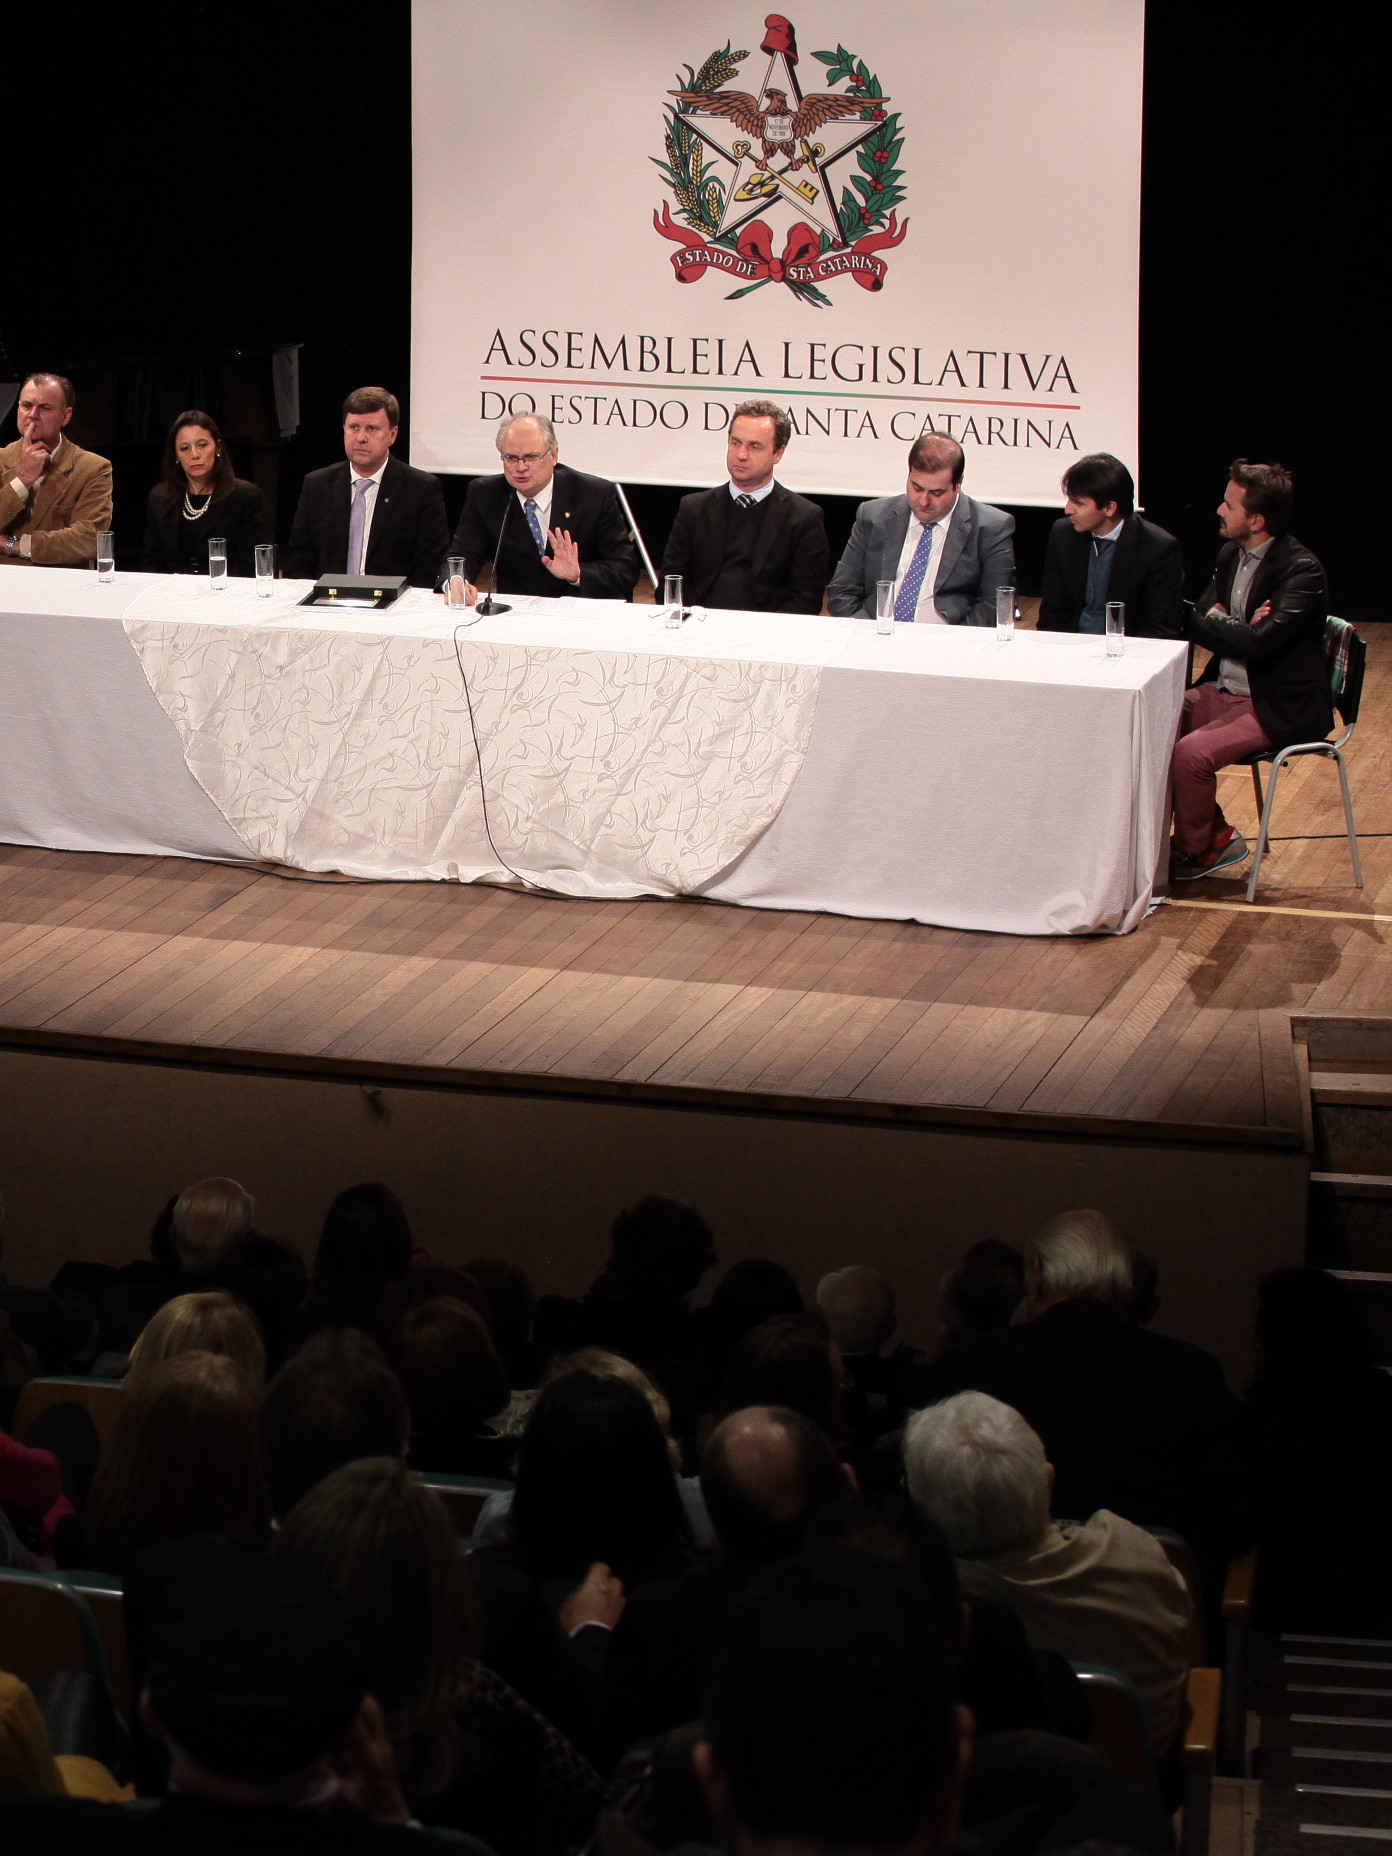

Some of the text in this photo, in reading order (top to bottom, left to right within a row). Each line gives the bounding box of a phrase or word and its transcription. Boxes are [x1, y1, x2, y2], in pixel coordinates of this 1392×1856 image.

[676, 250, 734, 268] ESTADO
[735, 260, 757, 277] DE
[818, 254, 883, 276] CATARINA
[481, 328, 1081, 394] ASSEMBLEIA LEGISLATIVA
[479, 390, 1081, 451] DO ESTADO D ANTA CATARINA
